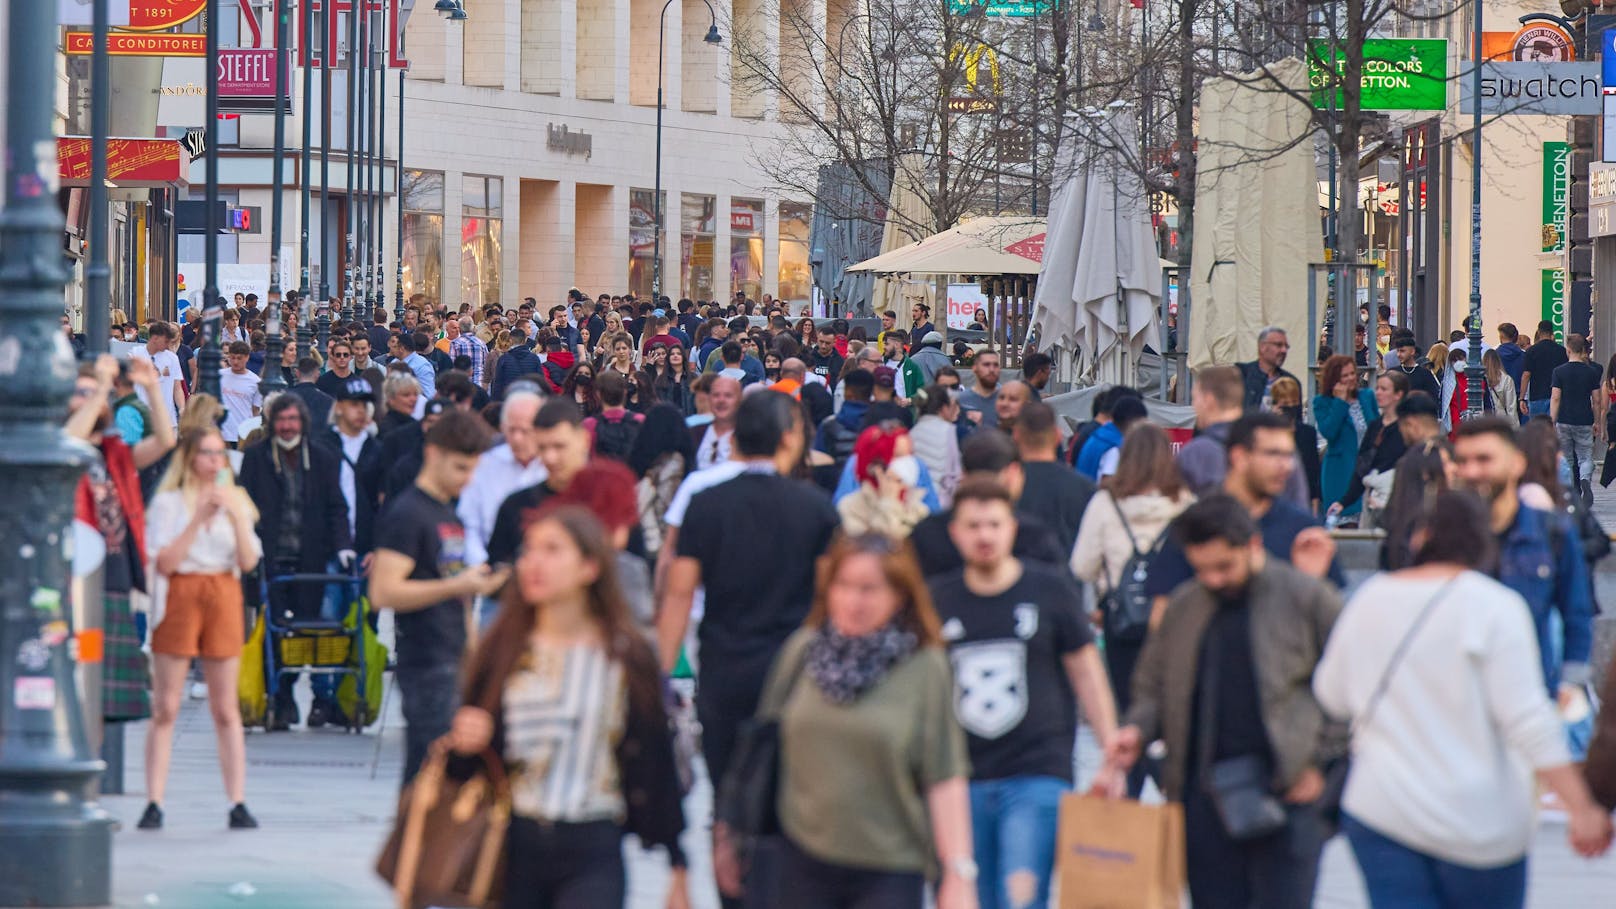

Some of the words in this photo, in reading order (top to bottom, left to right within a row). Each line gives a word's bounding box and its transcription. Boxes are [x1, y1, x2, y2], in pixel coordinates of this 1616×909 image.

[145, 8, 173, 17] 1891
[76, 38, 111, 48] CAE
[117, 38, 203, 49] CONDITOREI
[217, 54, 270, 81] STEFFL
[1366, 60, 1422, 73] COLORS
[1481, 74, 1598, 98] swatch
[1553, 147, 1567, 233] BENETTON.
